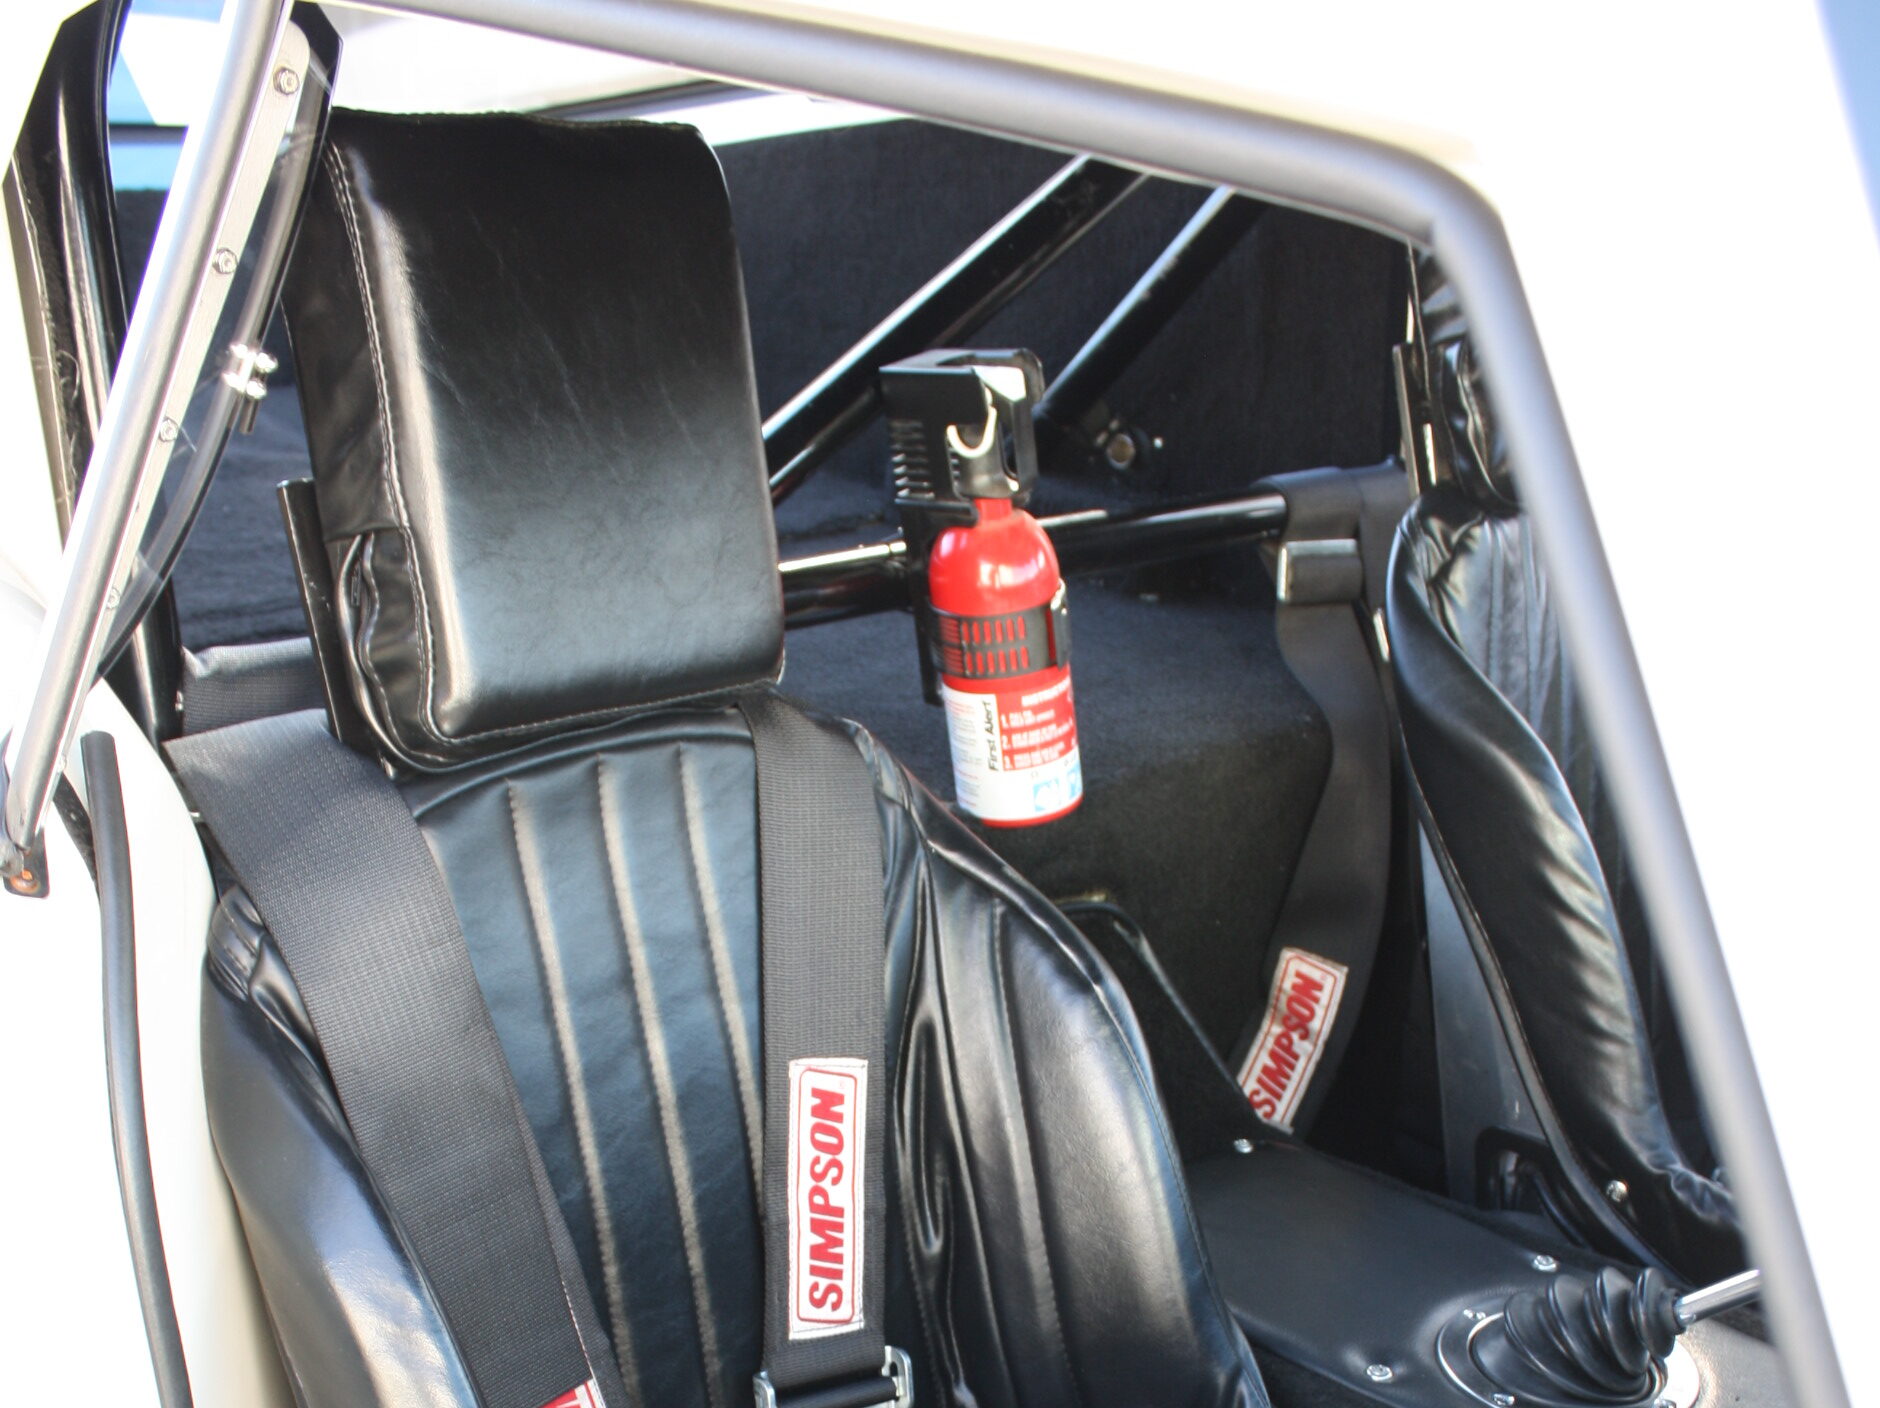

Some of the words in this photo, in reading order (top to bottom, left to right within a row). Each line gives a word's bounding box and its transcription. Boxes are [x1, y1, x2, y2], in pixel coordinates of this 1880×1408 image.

[982, 700, 994, 735] Alert
[985, 739, 999, 771] First
[1247, 969, 1324, 1120] SIMPSON
[808, 1087, 845, 1312] SIMPSON
